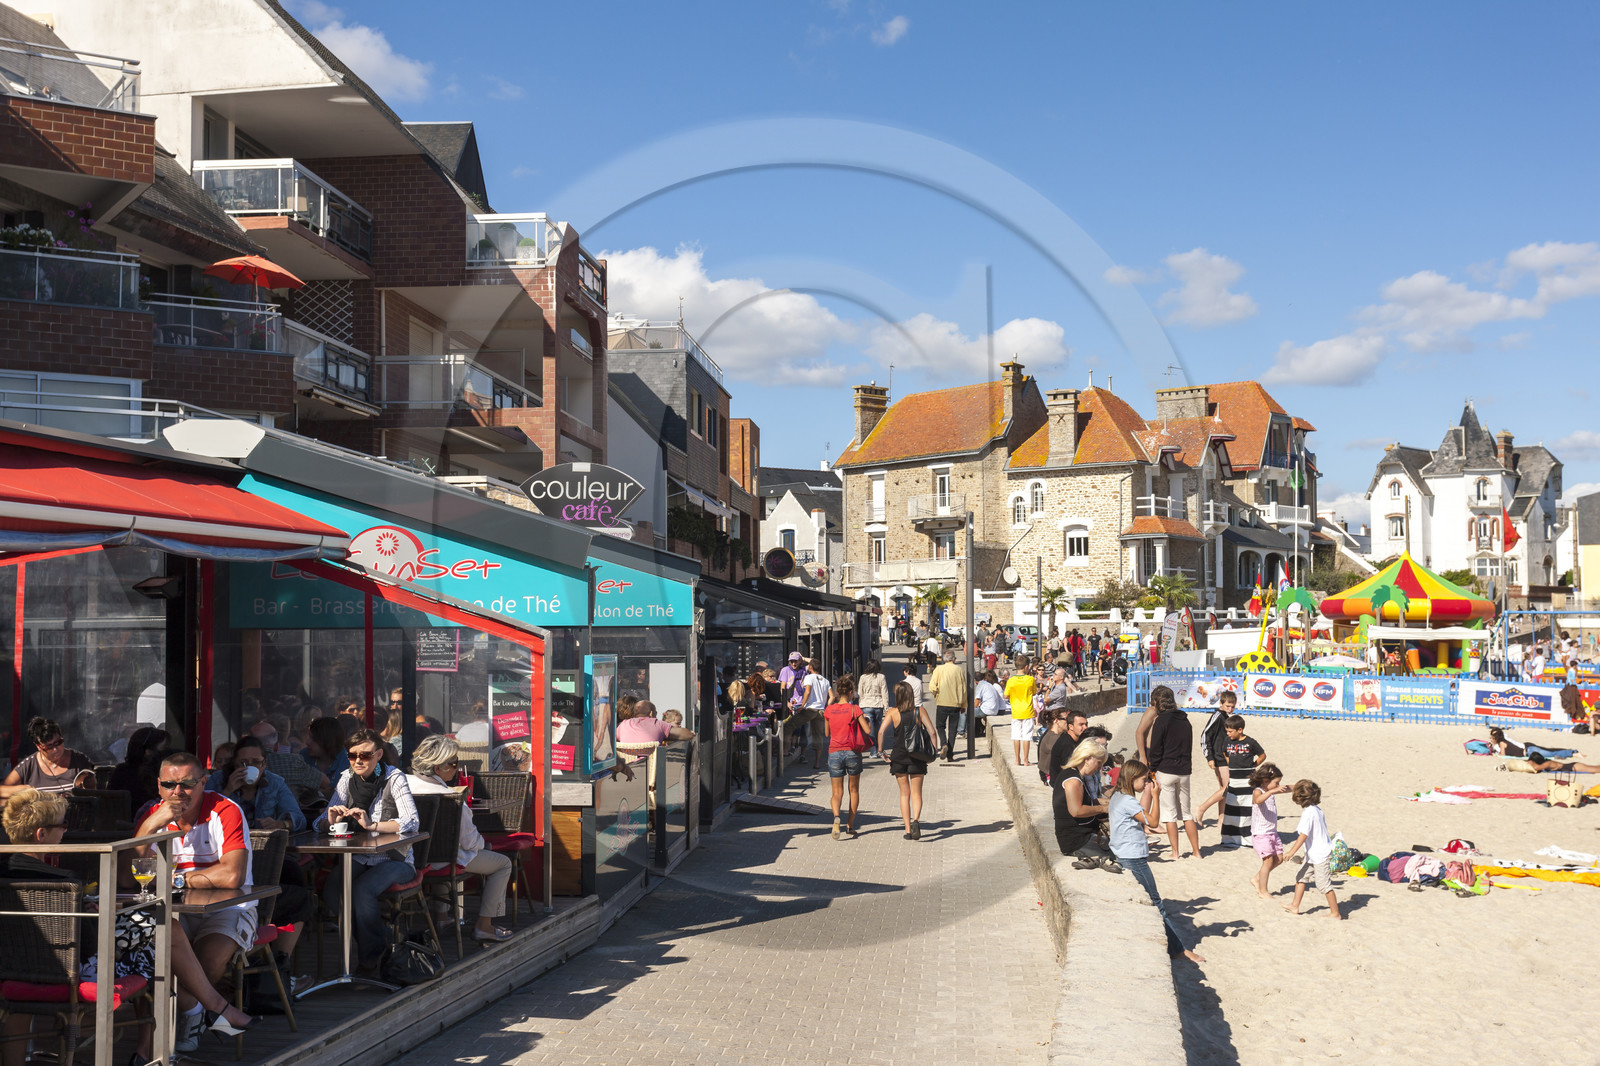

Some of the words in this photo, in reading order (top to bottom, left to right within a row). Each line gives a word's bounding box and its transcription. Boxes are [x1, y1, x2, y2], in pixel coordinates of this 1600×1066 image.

[530, 475, 634, 500] couleur
[561, 497, 619, 528] café
[253, 598, 287, 616] Bar
[490, 595, 517, 614] de
[522, 594, 562, 614] Thé
[625, 604, 643, 618] de
[646, 603, 674, 618] Thé
[1399, 694, 1444, 704] PARENTS
